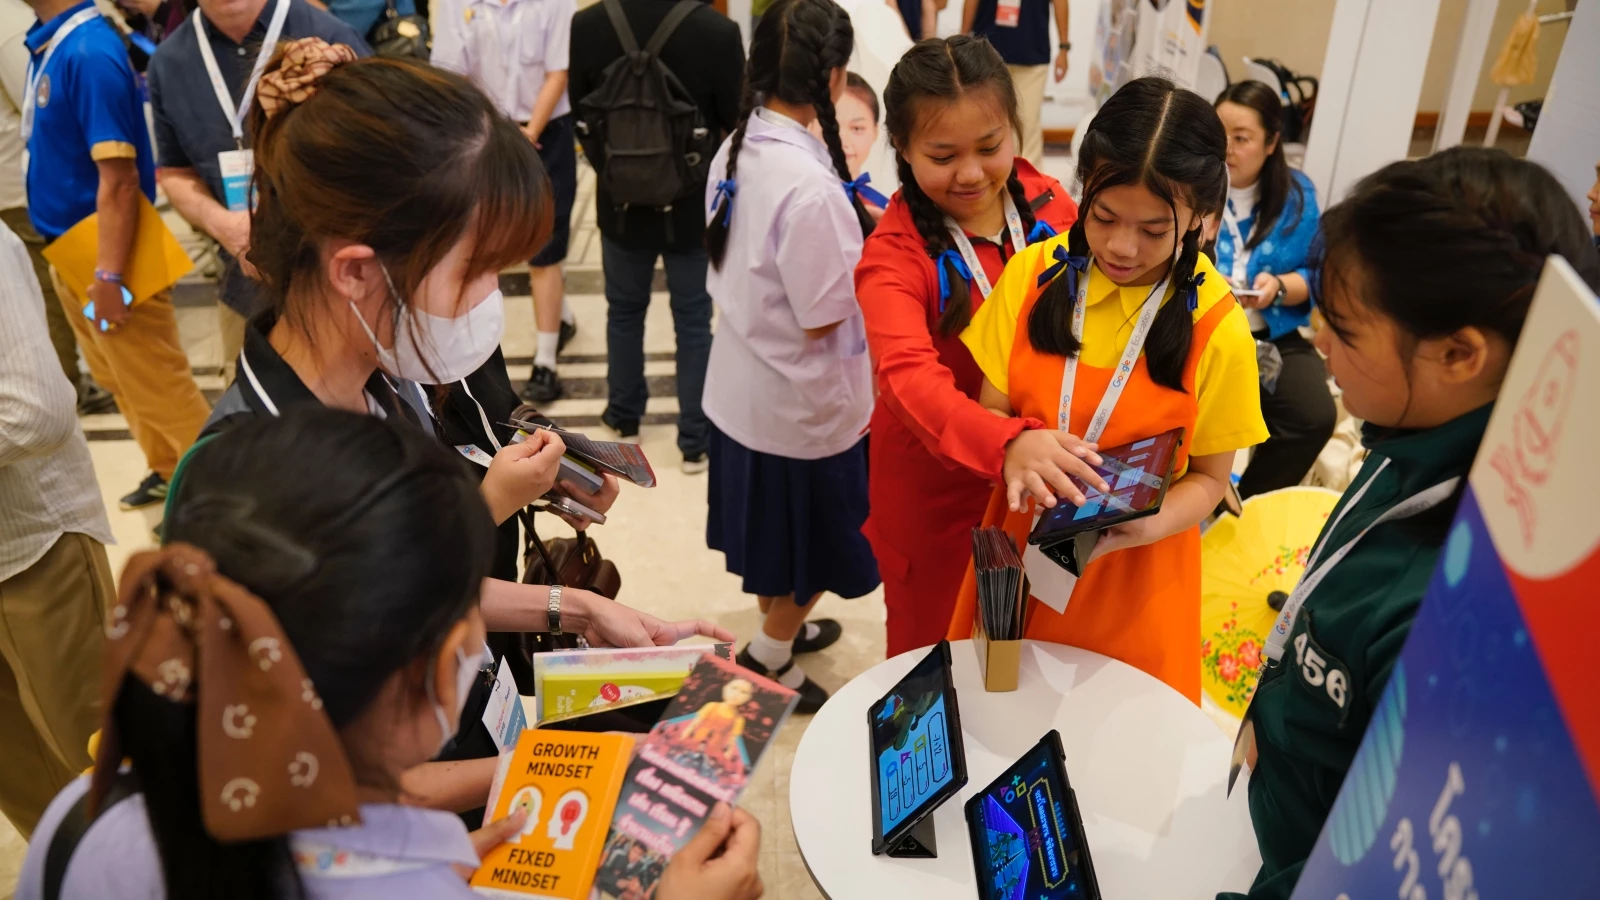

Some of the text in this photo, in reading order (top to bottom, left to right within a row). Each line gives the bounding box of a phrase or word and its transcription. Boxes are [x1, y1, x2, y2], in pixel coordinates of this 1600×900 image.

[1112, 308, 1153, 388] Google for Education
[1060, 394, 1071, 424] Google
[1276, 611, 1291, 635] Google
[1293, 632, 1347, 708] 456
[532, 742, 600, 760] GROWTH
[526, 761, 594, 779] MINDSET
[507, 848, 556, 868] FIXED
[491, 866, 561, 891] MINDSET
